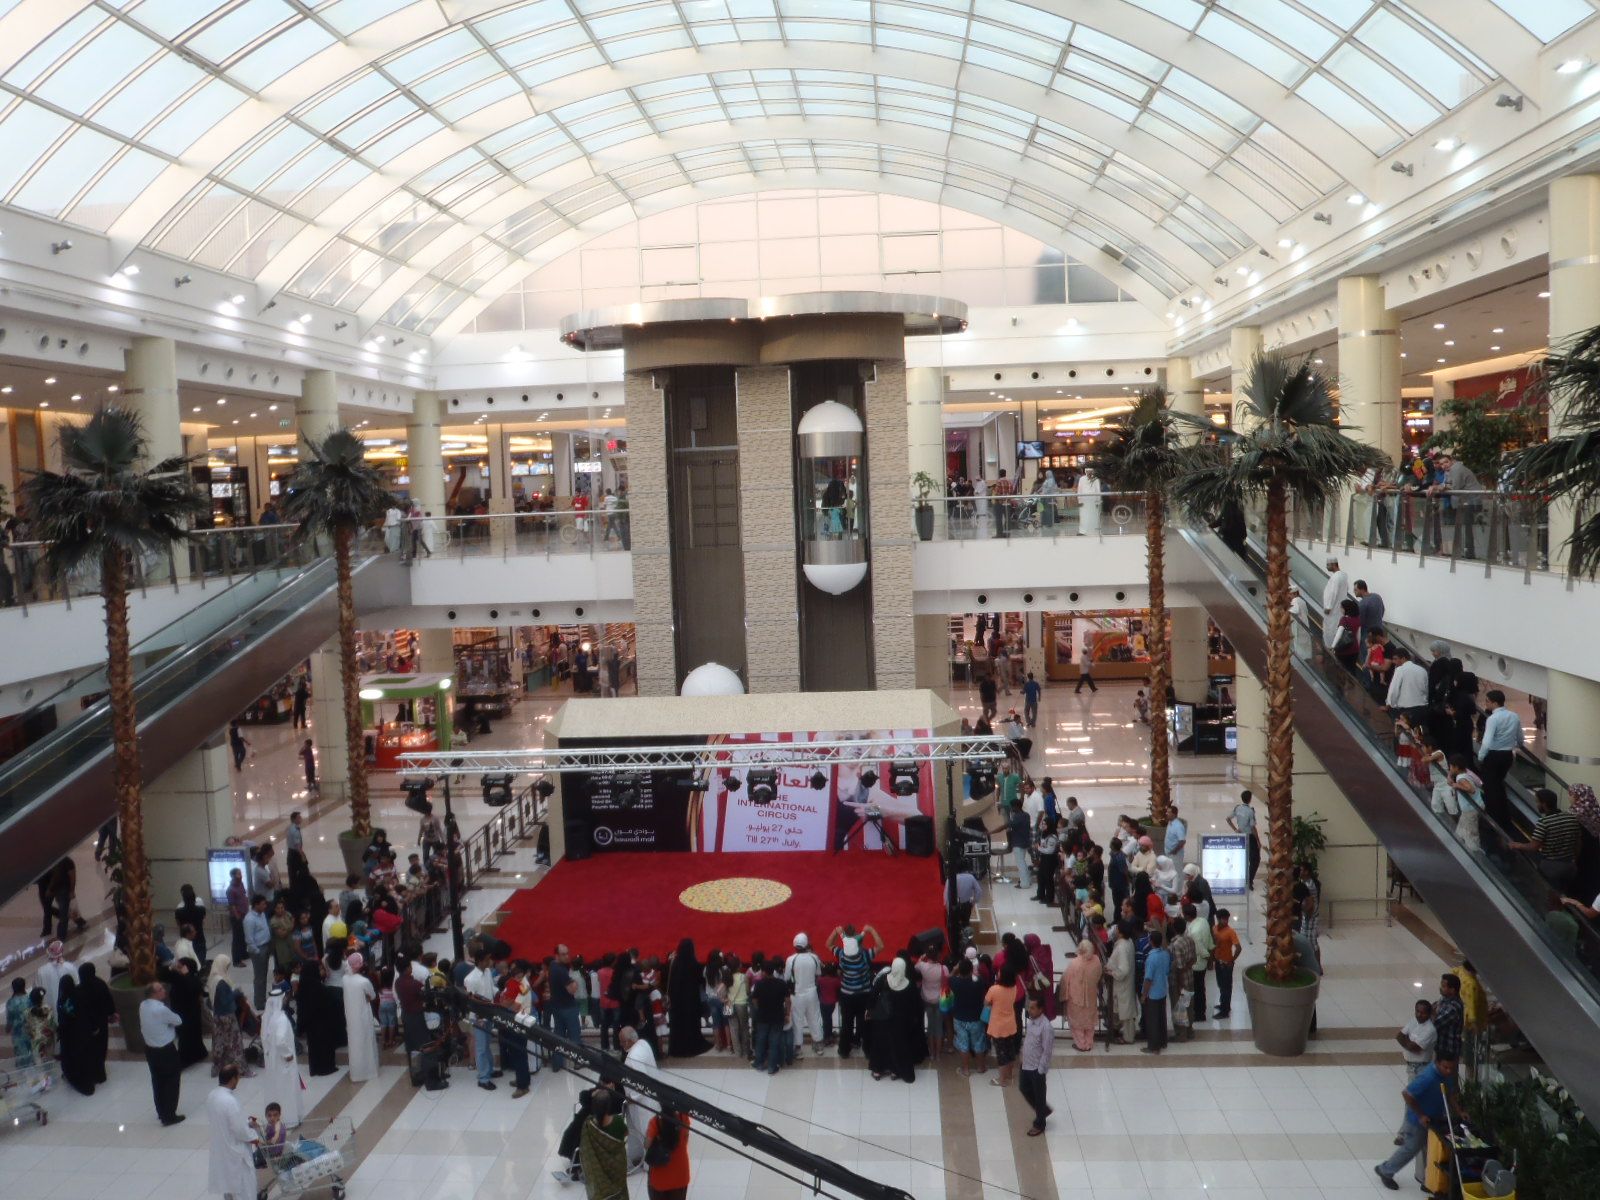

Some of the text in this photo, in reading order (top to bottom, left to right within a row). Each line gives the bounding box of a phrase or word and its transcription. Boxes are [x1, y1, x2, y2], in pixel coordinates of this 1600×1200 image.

[776, 794, 789, 802] HE
[757, 810, 797, 820] CIRCUS
[771, 823, 783, 832] 27
[746, 834, 758, 844] Till
